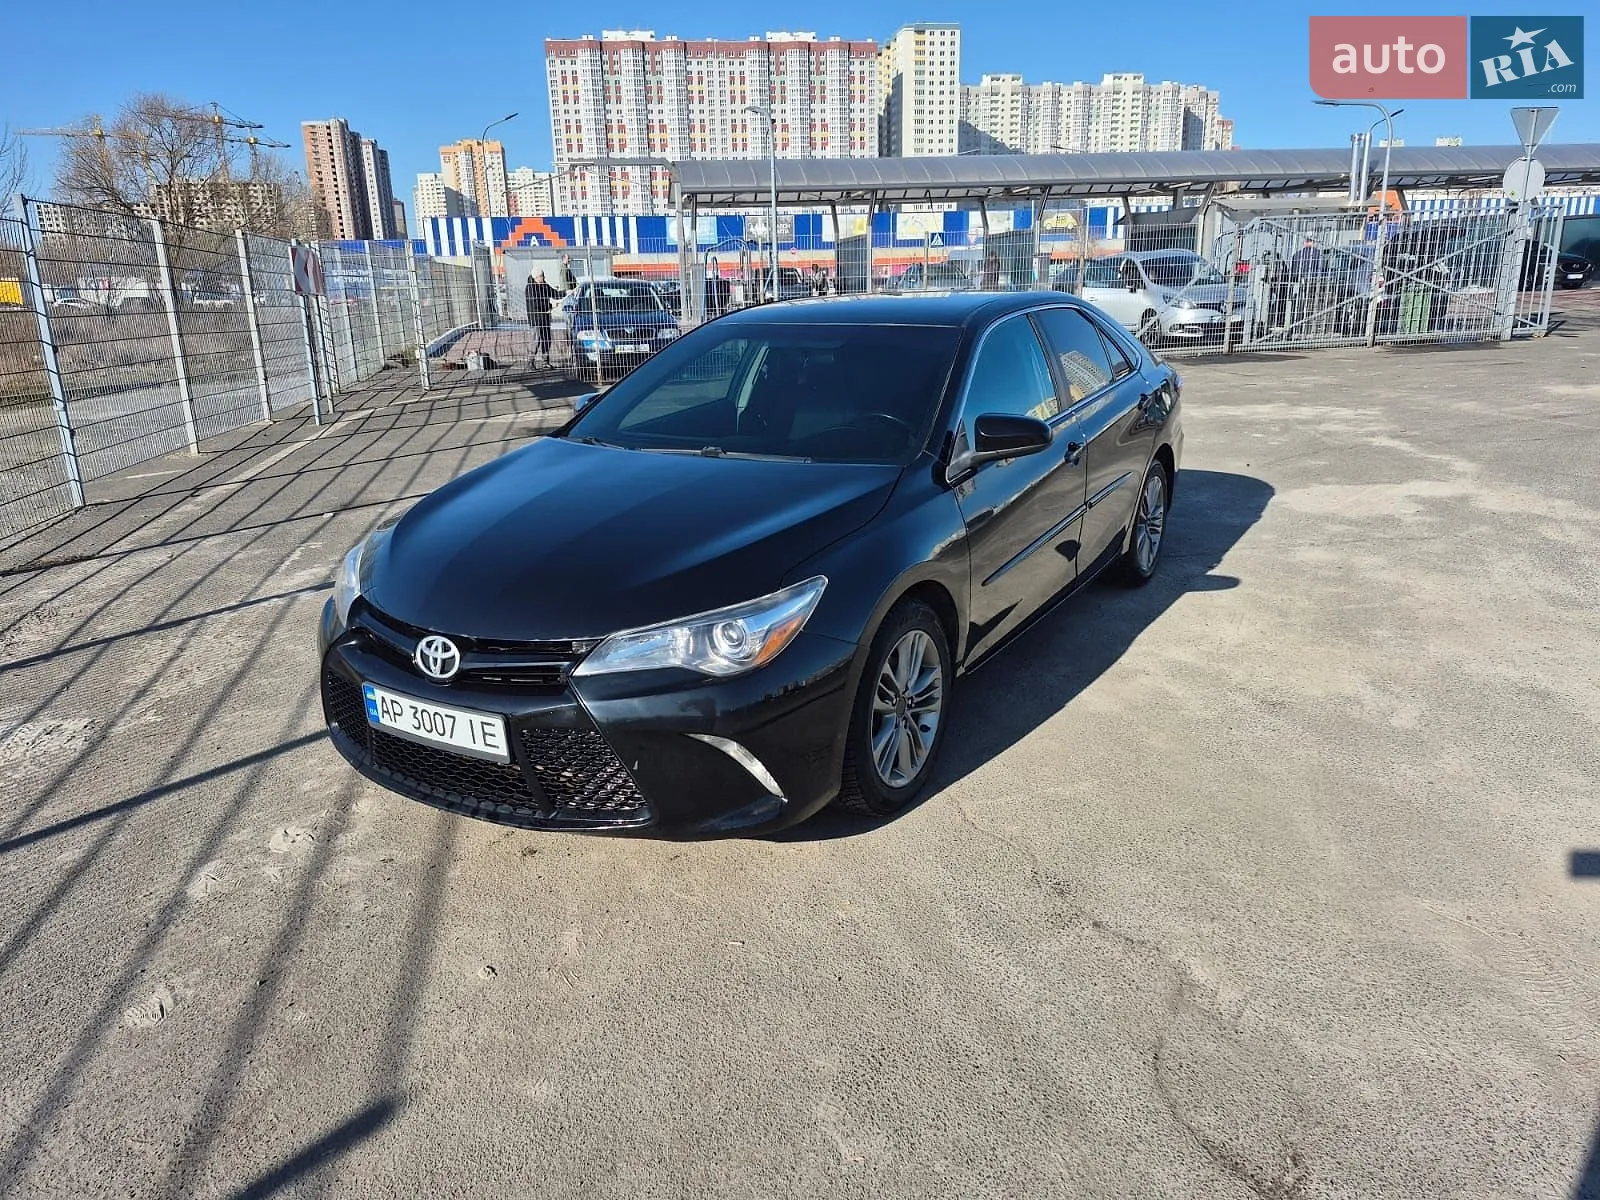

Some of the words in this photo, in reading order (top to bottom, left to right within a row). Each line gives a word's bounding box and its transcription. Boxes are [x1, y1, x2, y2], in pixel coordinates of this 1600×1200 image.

[381, 695, 404, 723] AP
[409, 705, 456, 739] 3007
[469, 719, 499, 749] IE
